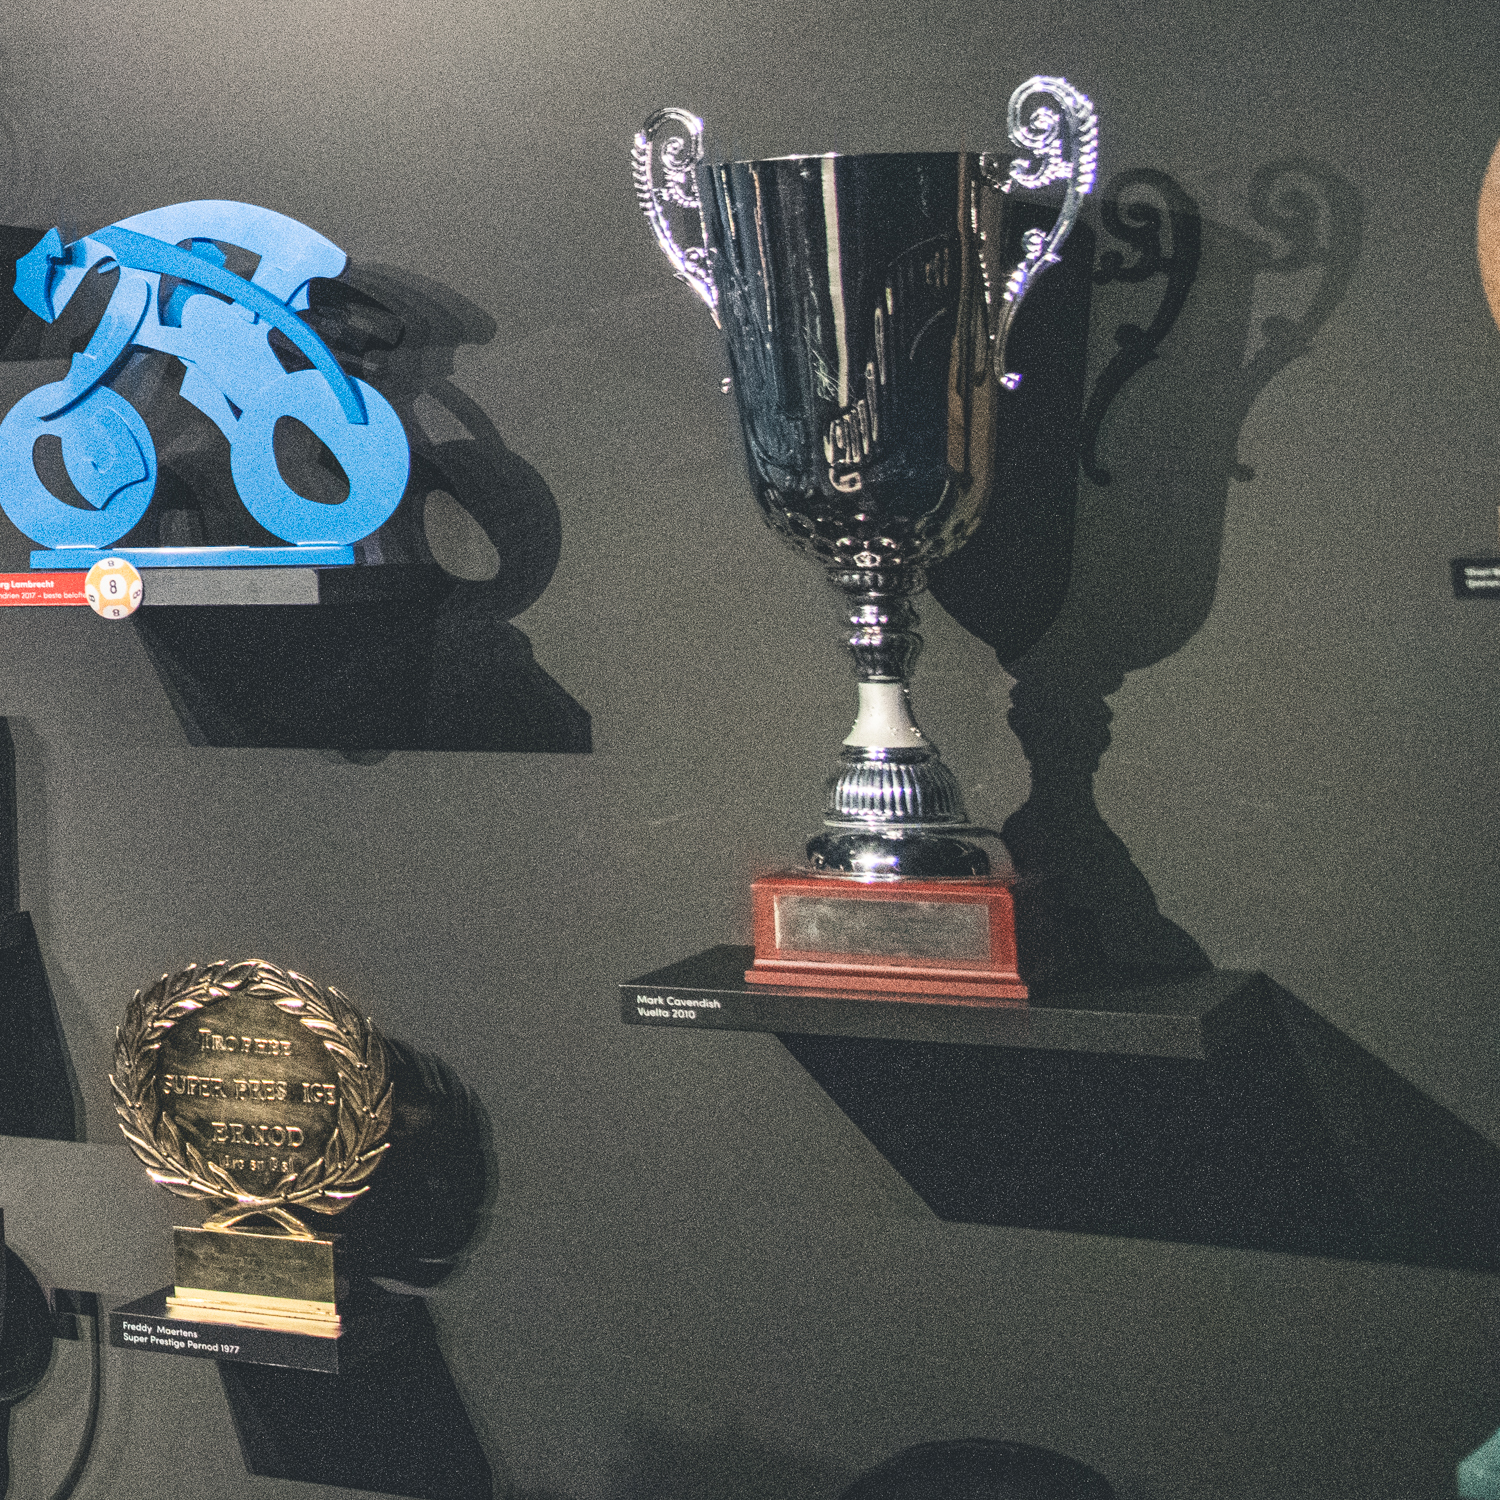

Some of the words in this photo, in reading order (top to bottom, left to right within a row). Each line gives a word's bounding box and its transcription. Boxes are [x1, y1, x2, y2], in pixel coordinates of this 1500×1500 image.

[11, 580, 54, 589] Lambrecht
[109, 579, 118, 594] 8
[636, 995, 665, 1005] Mark
[666, 996, 721, 1009] Cavendish
[637, 1007, 670, 1018] Vuelta
[671, 1009, 696, 1020] 2010
[164, 1073, 228, 1099] SUPER
[233, 1078, 336, 1106] PRESIGE
[205, 1120, 304, 1147] ERNOD
[122, 1321, 152, 1333] Freddy
[156, 1325, 198, 1338] Maertens
[123, 1332, 149, 1344] Super
[150, 1335, 186, 1349] Prestige
[187, 1340, 219, 1352] Pernod
[220, 1344, 240, 1354] 1977
